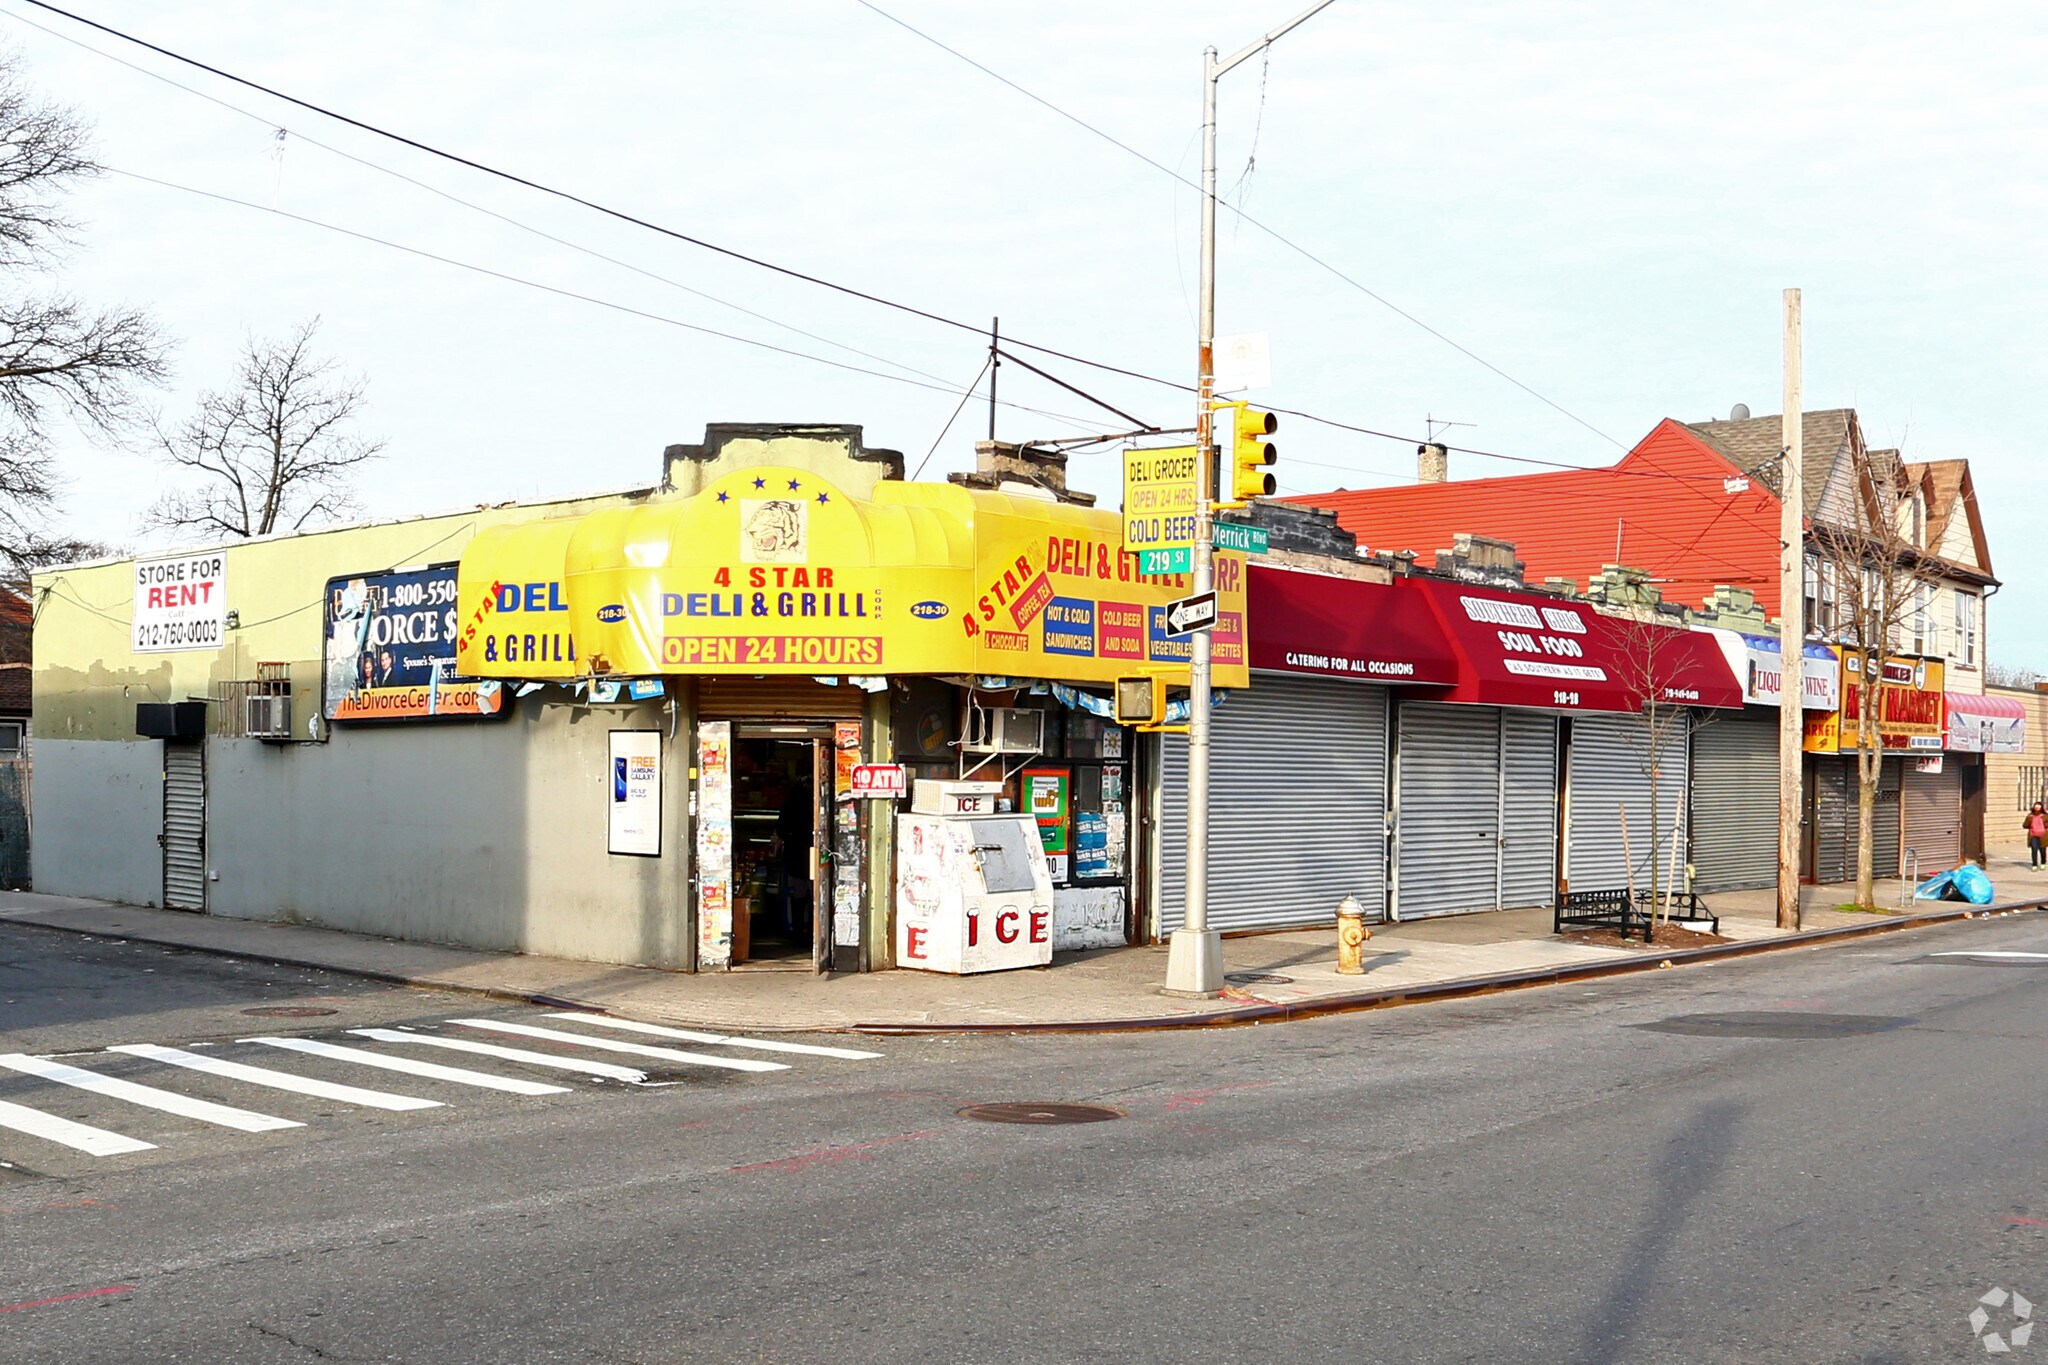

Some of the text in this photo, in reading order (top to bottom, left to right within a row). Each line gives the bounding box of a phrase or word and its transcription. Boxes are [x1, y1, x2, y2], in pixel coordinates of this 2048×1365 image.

[1131, 461, 1151, 482] DELI
[1133, 487, 1196, 509] OPEN 24 HRS.
[1130, 516, 1196, 543] COLD BEER
[1212, 524, 1267, 549] Merrick Blvd
[1047, 536, 1091, 577] DELI
[1097, 542, 1111, 580] &
[1147, 551, 1185, 572] 219 St
[139, 558, 221, 585] STORE FOR
[713, 567, 834, 588] 4 STAR
[148, 581, 214, 609] RENT
[496, 582, 568, 613] DEL
[963, 555, 1033, 638] 4 STAR
[1037, 582, 1052, 602] TEA
[168, 610, 185, 618] Call
[662, 592, 867, 617] DELI & GRILL
[913, 605, 947, 615] 218-30
[1047, 605, 1091, 625] HOT & COLD
[1175, 609, 1189, 624] ONE
[1195, 603, 1209, 619] WAY
[459, 637, 468, 654] 4
[465, 580, 504, 641] STAR
[1102, 610, 1121, 626] COLD
[1123, 612, 1142, 627] BEER
[1232, 618, 1238, 633] &
[1461, 597, 1586, 634] SOUTHERN GIRLS
[138, 619, 217, 646] 212-760-0003
[991, 633, 1028, 652] CHOCOLATE
[1045, 632, 1092, 651] SANDWICHES
[485, 634, 498, 662] &
[664, 637, 879, 664] OPEN 24 HOURS
[1104, 636, 1140, 653] AND SODA
[1150, 640, 1193, 657] VEGETABLES
[1497, 630, 1583, 657] SOUL FOOD
[403, 656, 427, 670] Spouse's
[1286, 652, 1414, 675] CATERING FOR ALL OCCASIONS
[1525, 663, 1562, 675] SOUTHERN
[1564, 666, 1574, 676] AS
[1757, 670, 1828, 696] LIQU WINE
[1886, 686, 1942, 724] MARKET
[1805, 724, 1837, 737] ARKET
[630, 756, 656, 767] FREE
[871, 769, 903, 788] ATM
[957, 796, 981, 812] ICE
[967, 905, 1050, 947] ICE
